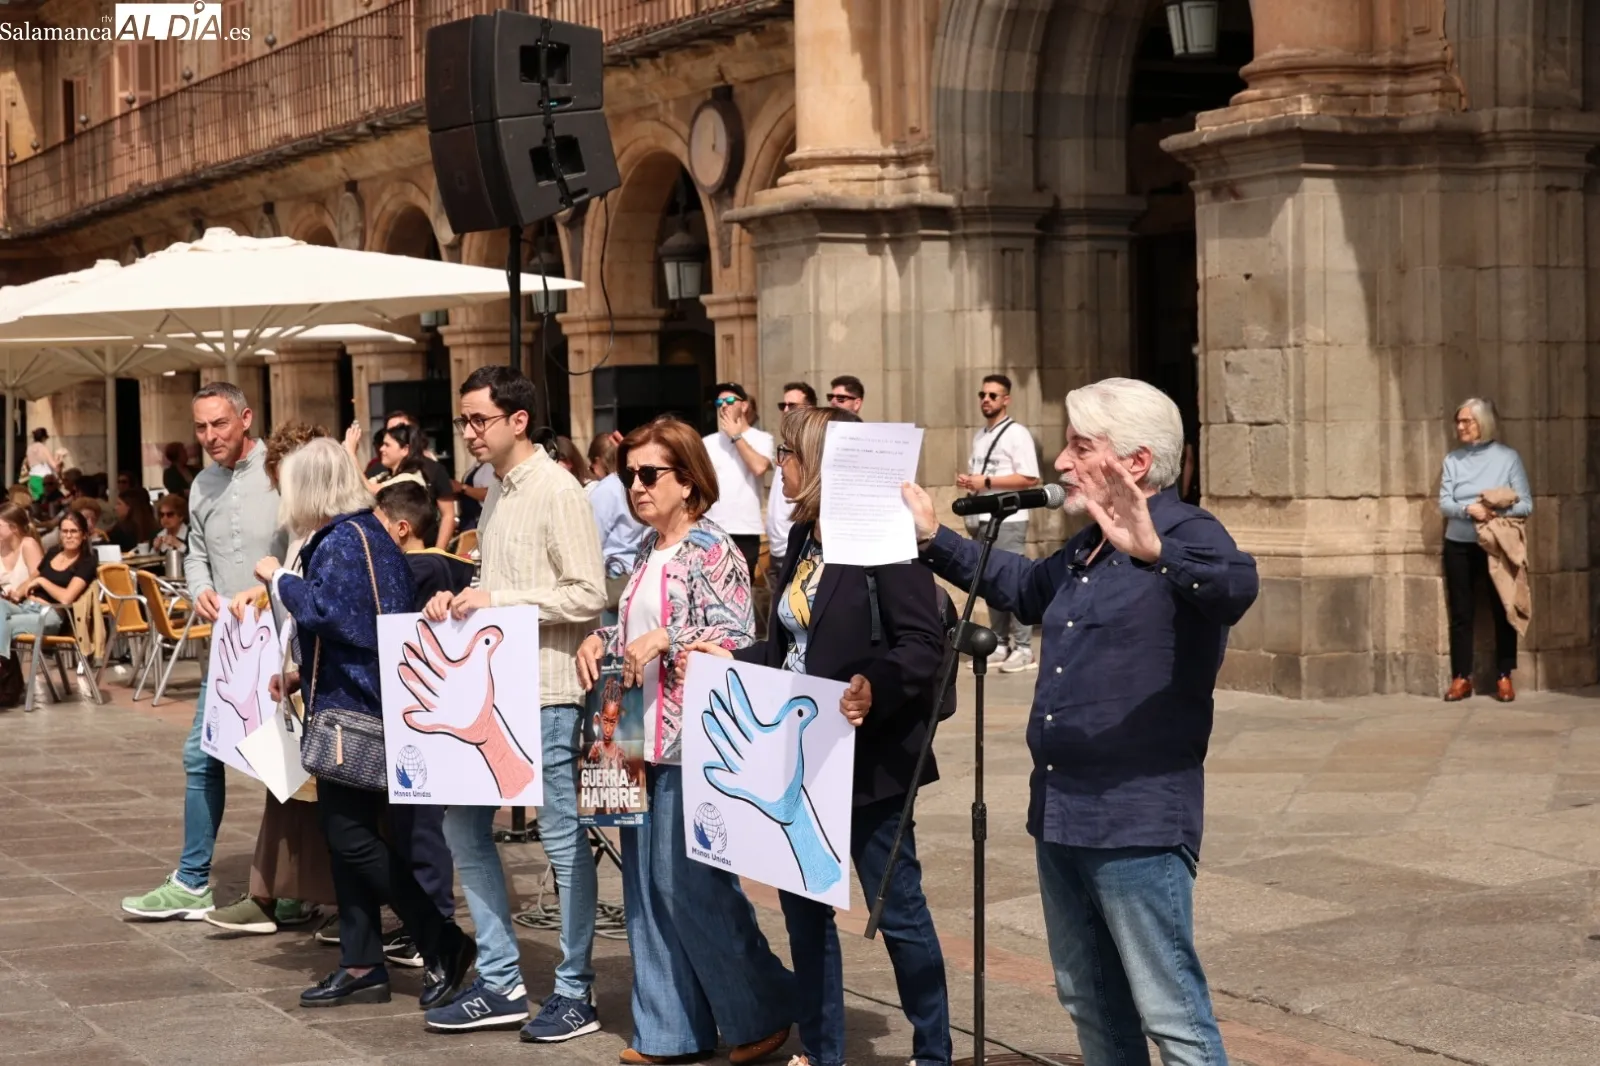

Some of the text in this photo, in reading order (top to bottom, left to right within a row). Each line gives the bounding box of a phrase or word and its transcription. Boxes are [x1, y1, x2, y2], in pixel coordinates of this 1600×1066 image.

[581, 768, 629, 787] GUERRA
[581, 787, 641, 808] HAMBRE
[691, 846, 732, 867] Manos Unidas
[462, 997, 492, 1019] N
[562, 1008, 585, 1030] N
